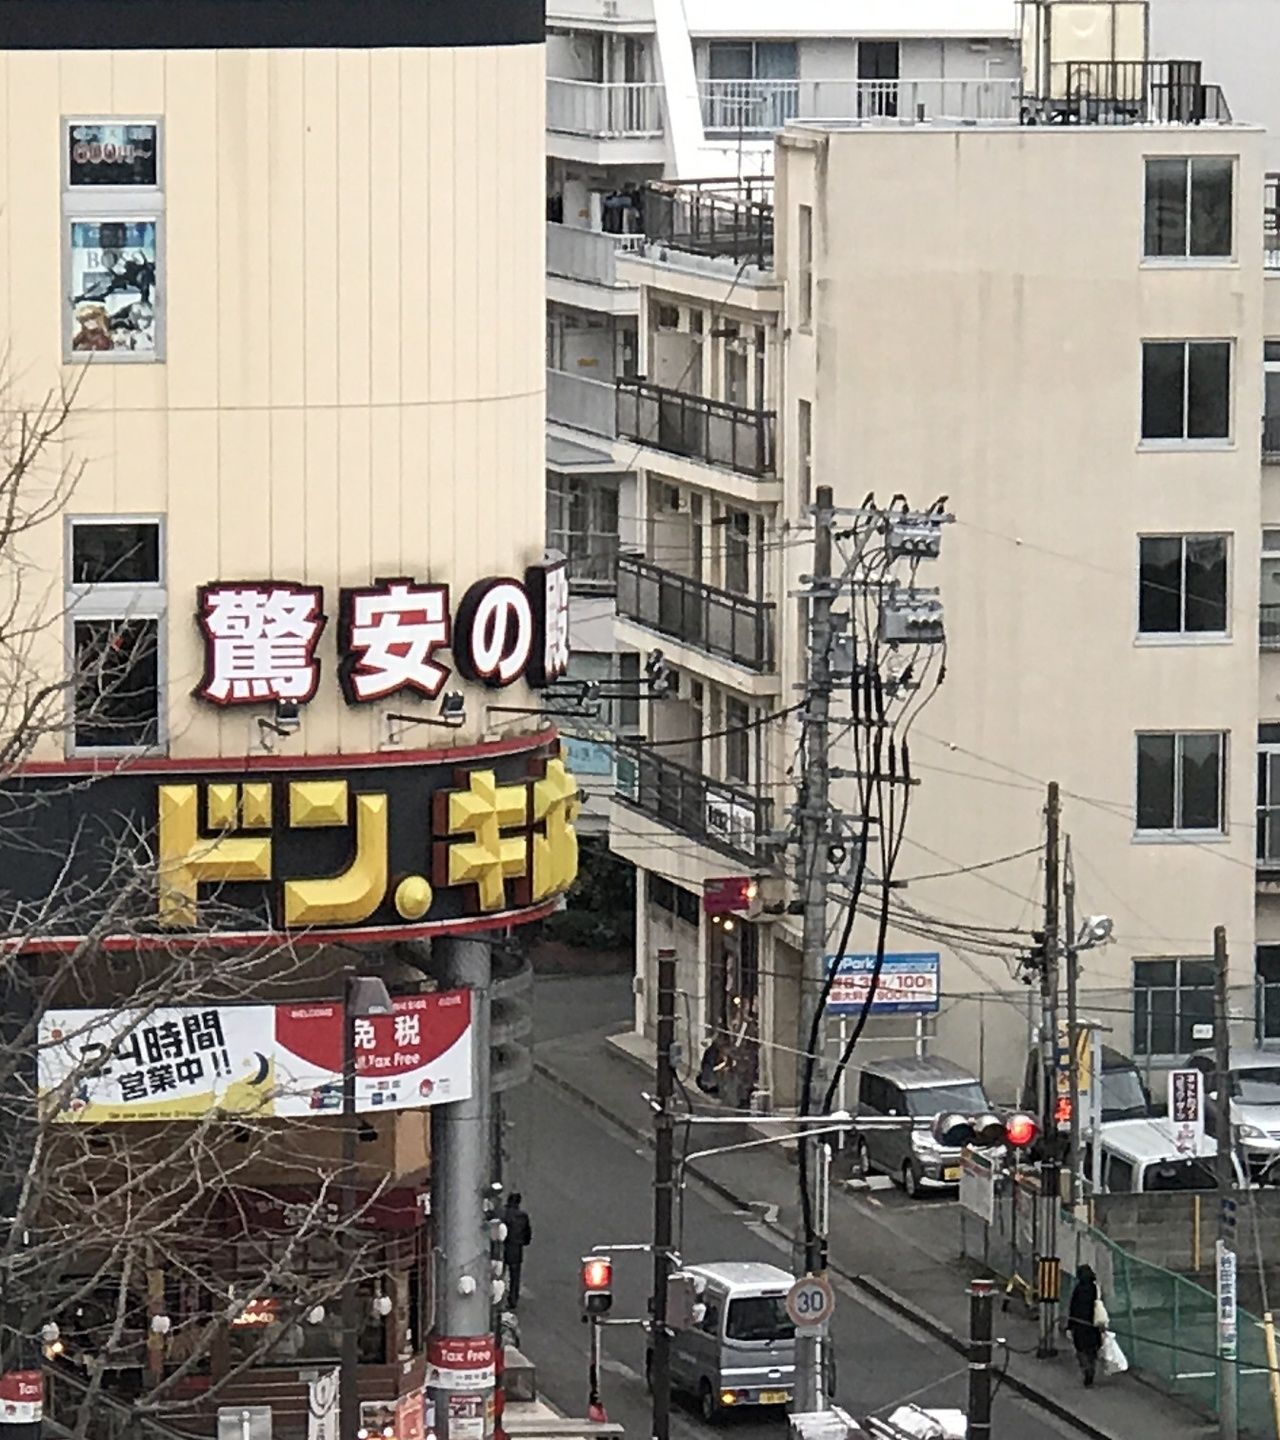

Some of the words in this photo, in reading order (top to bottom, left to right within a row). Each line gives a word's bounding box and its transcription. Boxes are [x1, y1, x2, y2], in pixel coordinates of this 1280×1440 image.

[368, 1054, 392, 1069] Tax
[798, 1290, 824, 1313] 30
[441, 1350, 465, 1362] Tax
